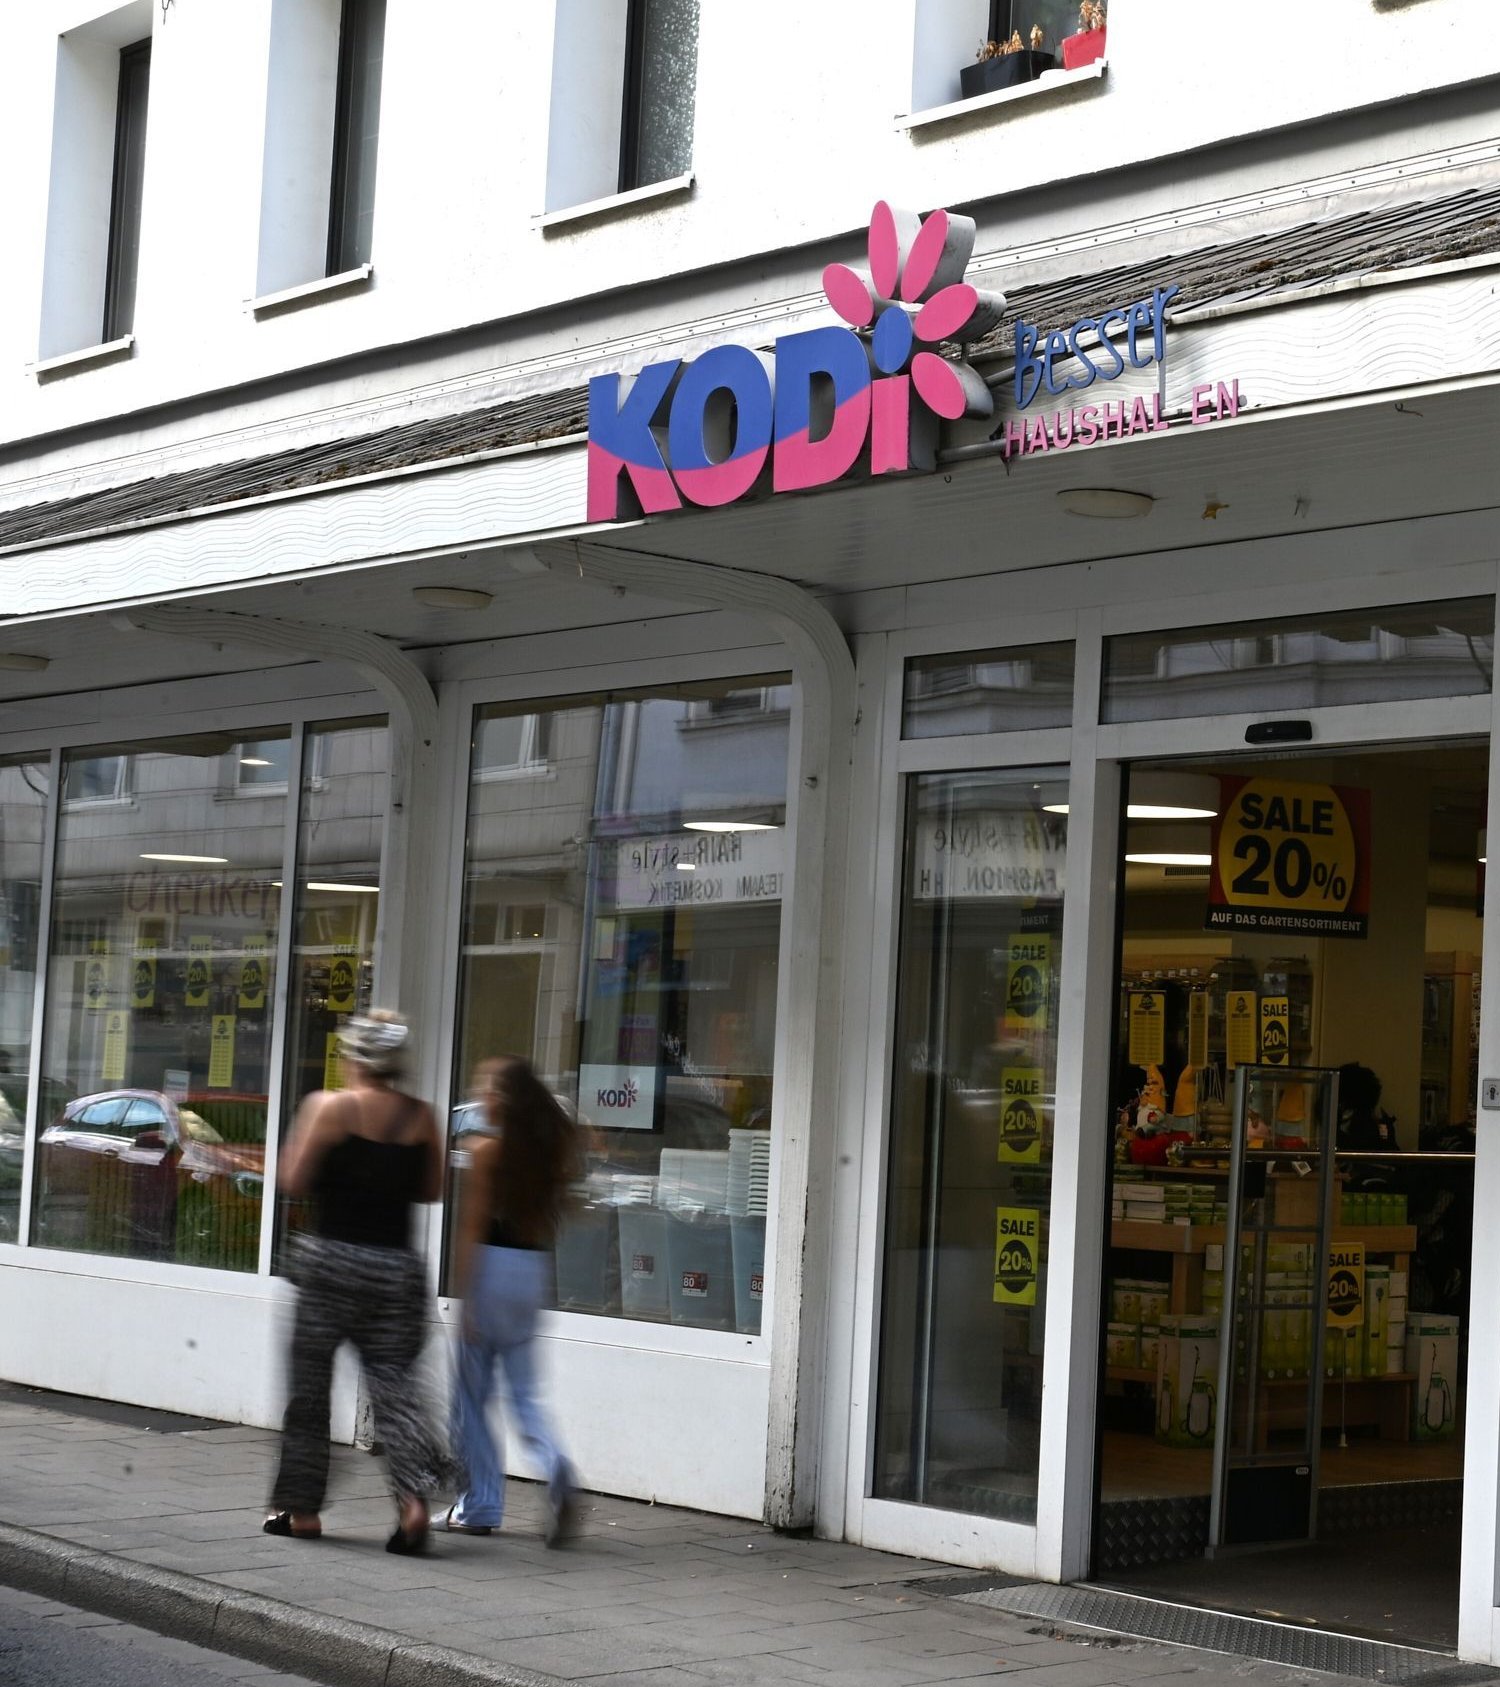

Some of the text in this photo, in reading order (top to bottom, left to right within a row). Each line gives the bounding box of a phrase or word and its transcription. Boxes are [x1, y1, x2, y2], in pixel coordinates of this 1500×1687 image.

[1014, 284, 1180, 411] Besser
[1238, 792, 1334, 836] SALE
[1232, 834, 1347, 900] 20%
[1211, 912, 1361, 932] AUF DAS GARTENSORTIMENT
[1012, 944, 1045, 960] SALE
[1263, 1004, 1287, 1017] SALE
[1005, 1079, 1039, 1095] SALE
[1005, 1110, 1036, 1131] 20%
[1001, 1219, 1034, 1236] SALE
[1000, 1250, 1032, 1271] 20%
[1328, 1253, 1360, 1267] SALE
[683, 1276, 695, 1288] 80
[1329, 1279, 1358, 1298] 20%
